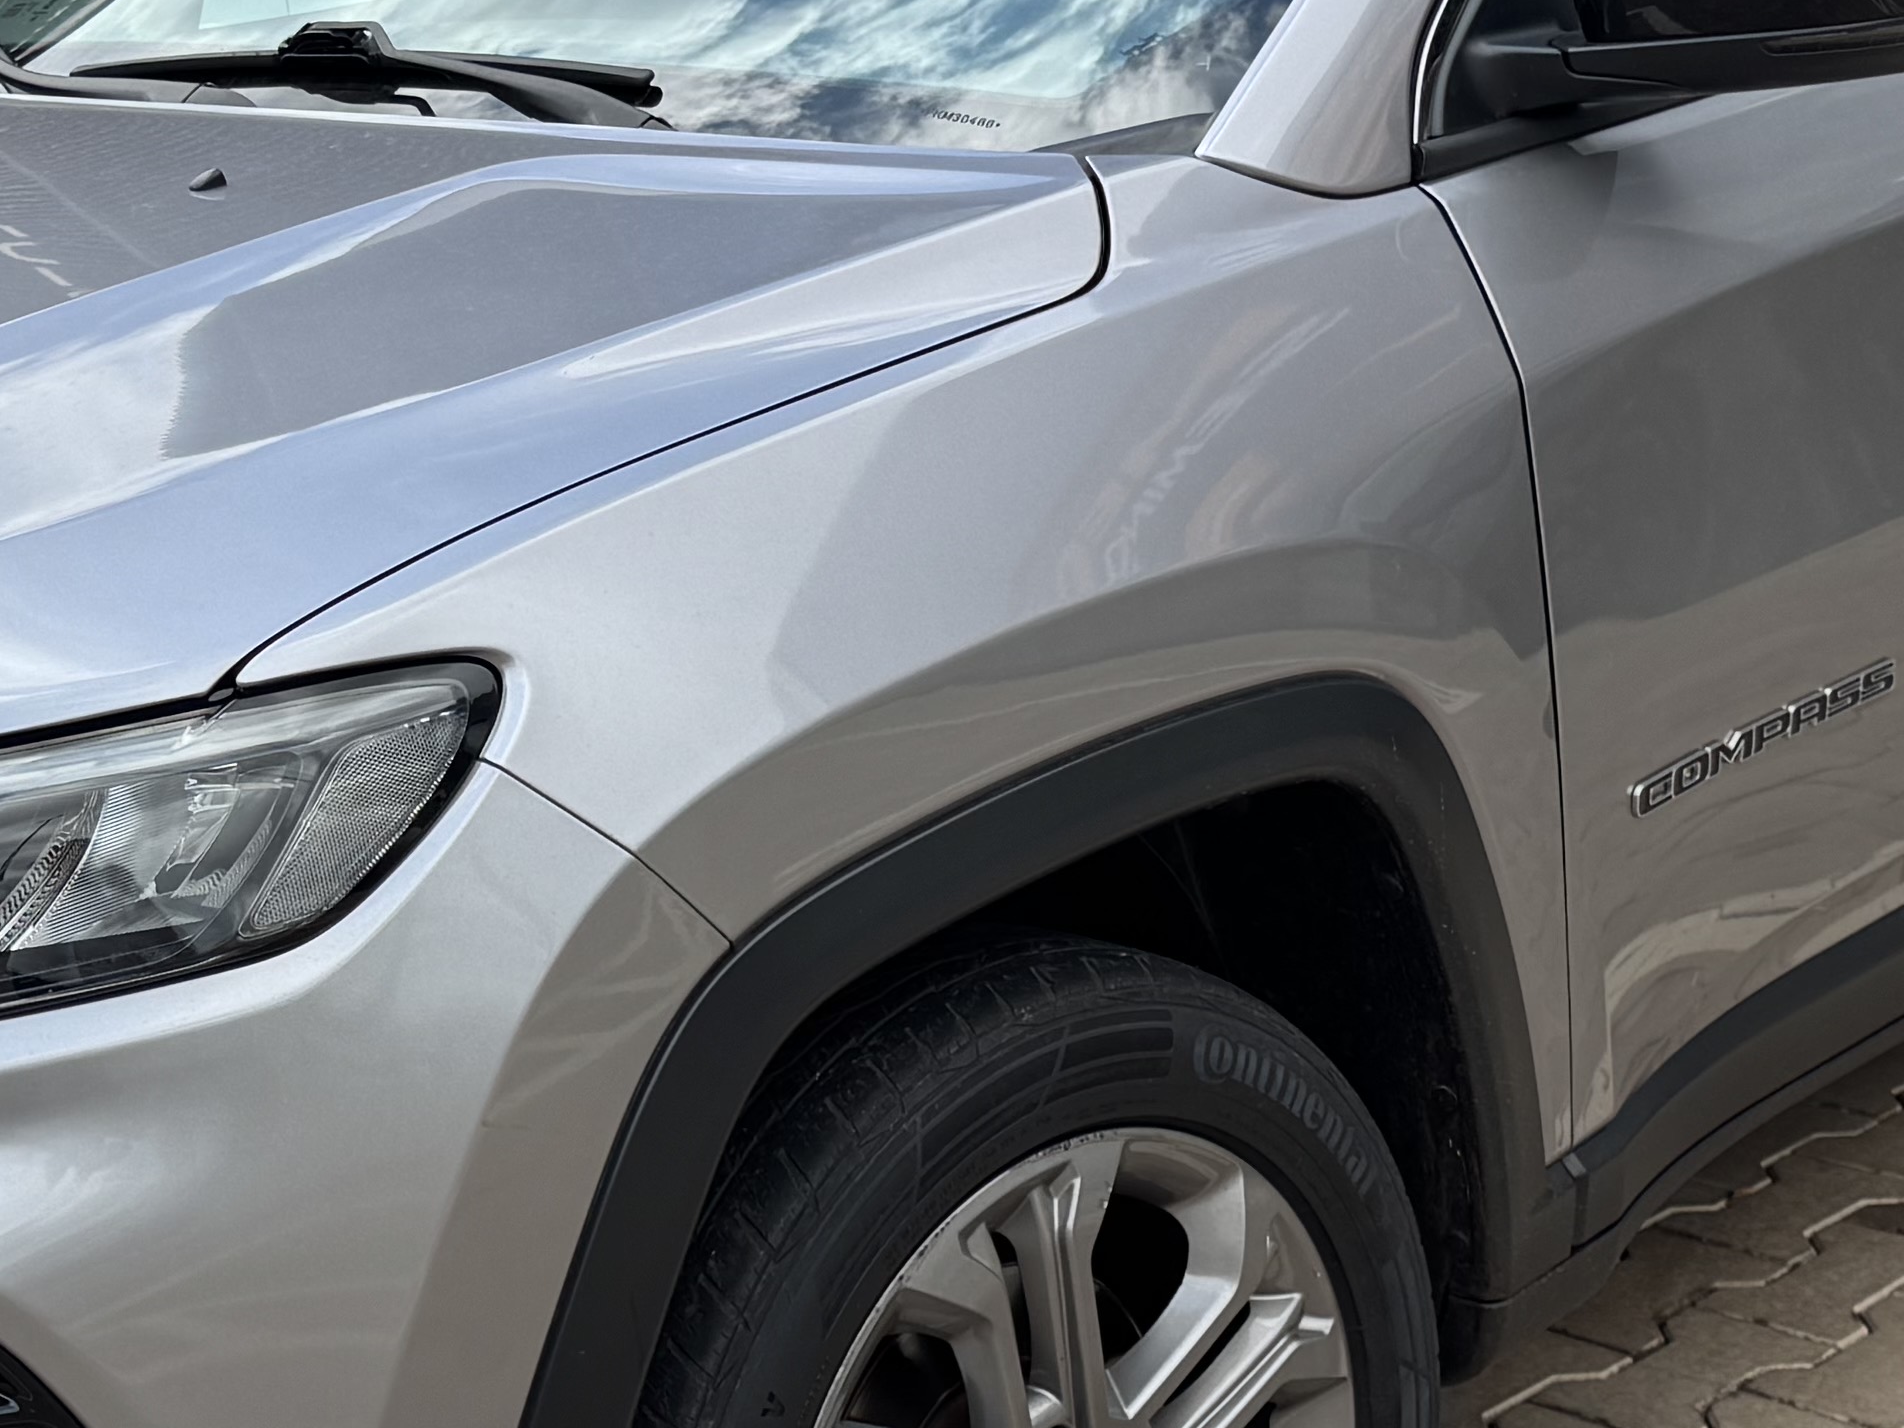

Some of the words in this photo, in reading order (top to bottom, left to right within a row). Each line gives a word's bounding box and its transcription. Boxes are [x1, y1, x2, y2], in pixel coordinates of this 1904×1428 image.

[1627, 656, 1895, 818] COMPASS
[1192, 1022, 1376, 1196] Continental
[760, 1390, 786, 1418] V
